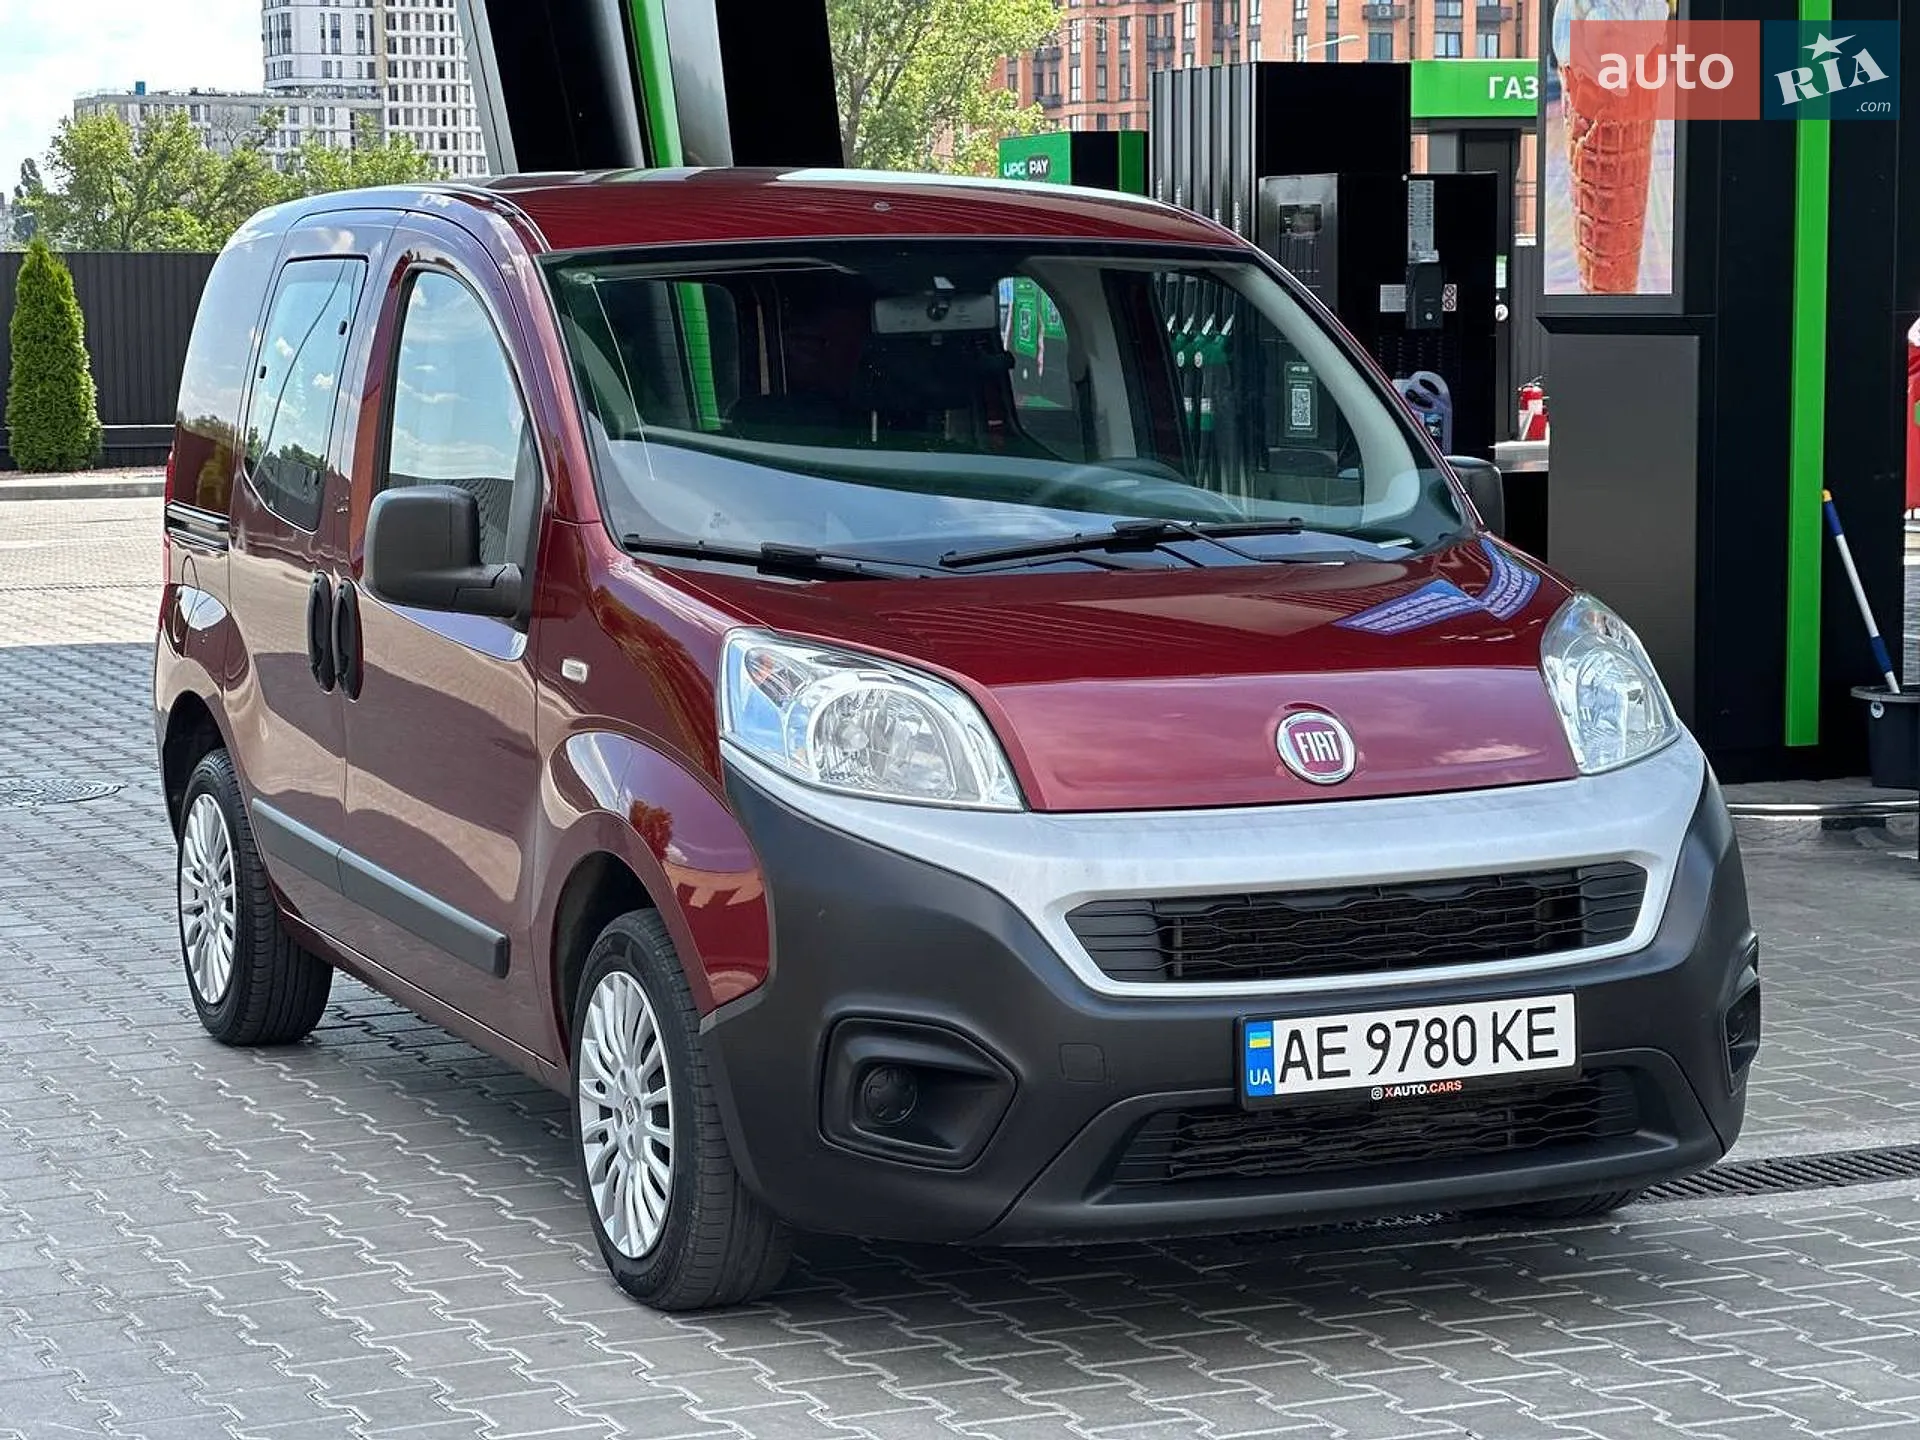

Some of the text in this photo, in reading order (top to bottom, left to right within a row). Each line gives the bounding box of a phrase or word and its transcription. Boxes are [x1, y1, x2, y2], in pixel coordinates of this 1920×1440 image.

[1488, 76, 1539, 100] ГАЗ
[1003, 159, 1049, 177] UPG PAY
[1295, 731, 1341, 763] FIAT
[1279, 1006, 1559, 1083] AE 9780 KE
[1250, 1068, 1272, 1086] UA
